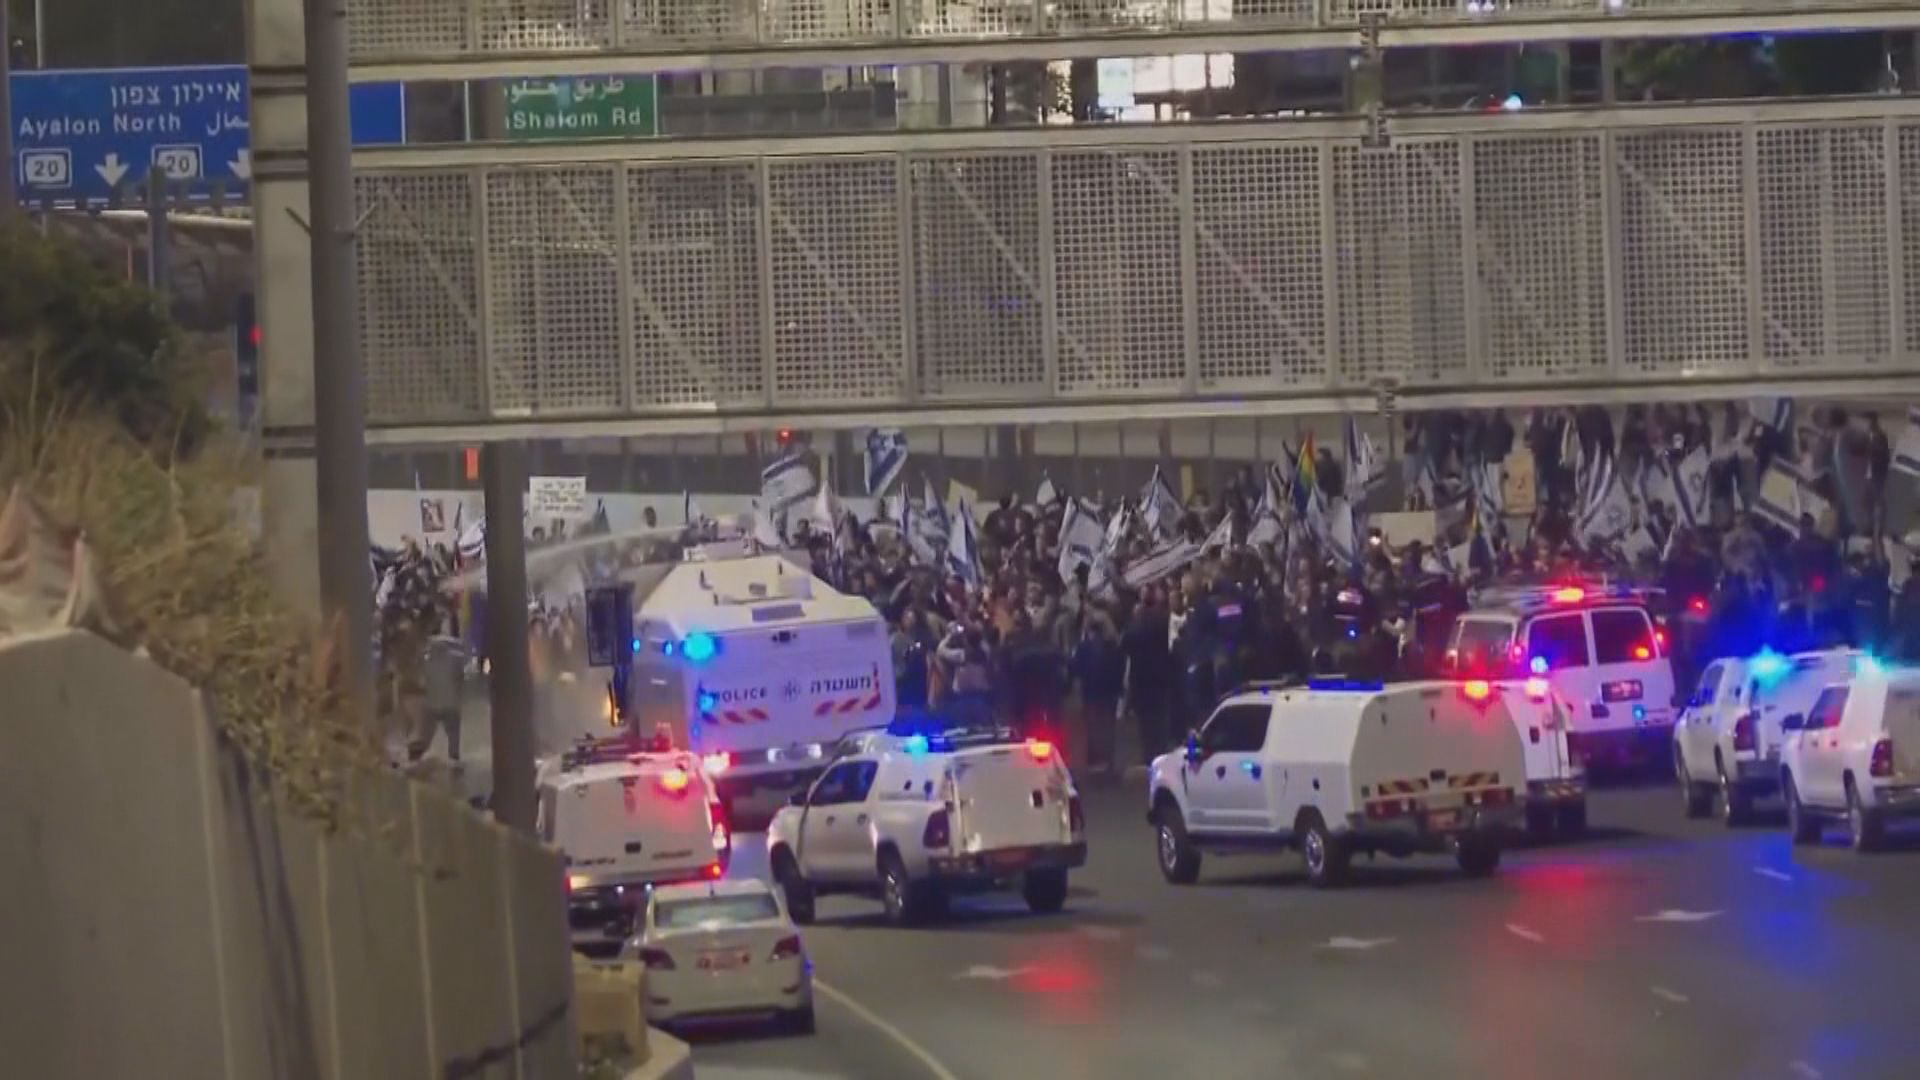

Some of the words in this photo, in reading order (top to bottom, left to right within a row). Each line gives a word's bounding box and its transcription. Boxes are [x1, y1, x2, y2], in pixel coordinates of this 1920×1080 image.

[110, 85, 160, 108] צפון
[172, 82, 241, 106] איילון
[19, 116, 100, 141] Ayalon
[113, 112, 181, 133] North
[206, 111, 249, 137] مال
[504, 110, 598, 130] Shalom
[612, 107, 641, 126] Rd
[34, 160, 59, 177] 20
[165, 155, 190, 172] 20
[810, 676, 872, 694] משטרה
